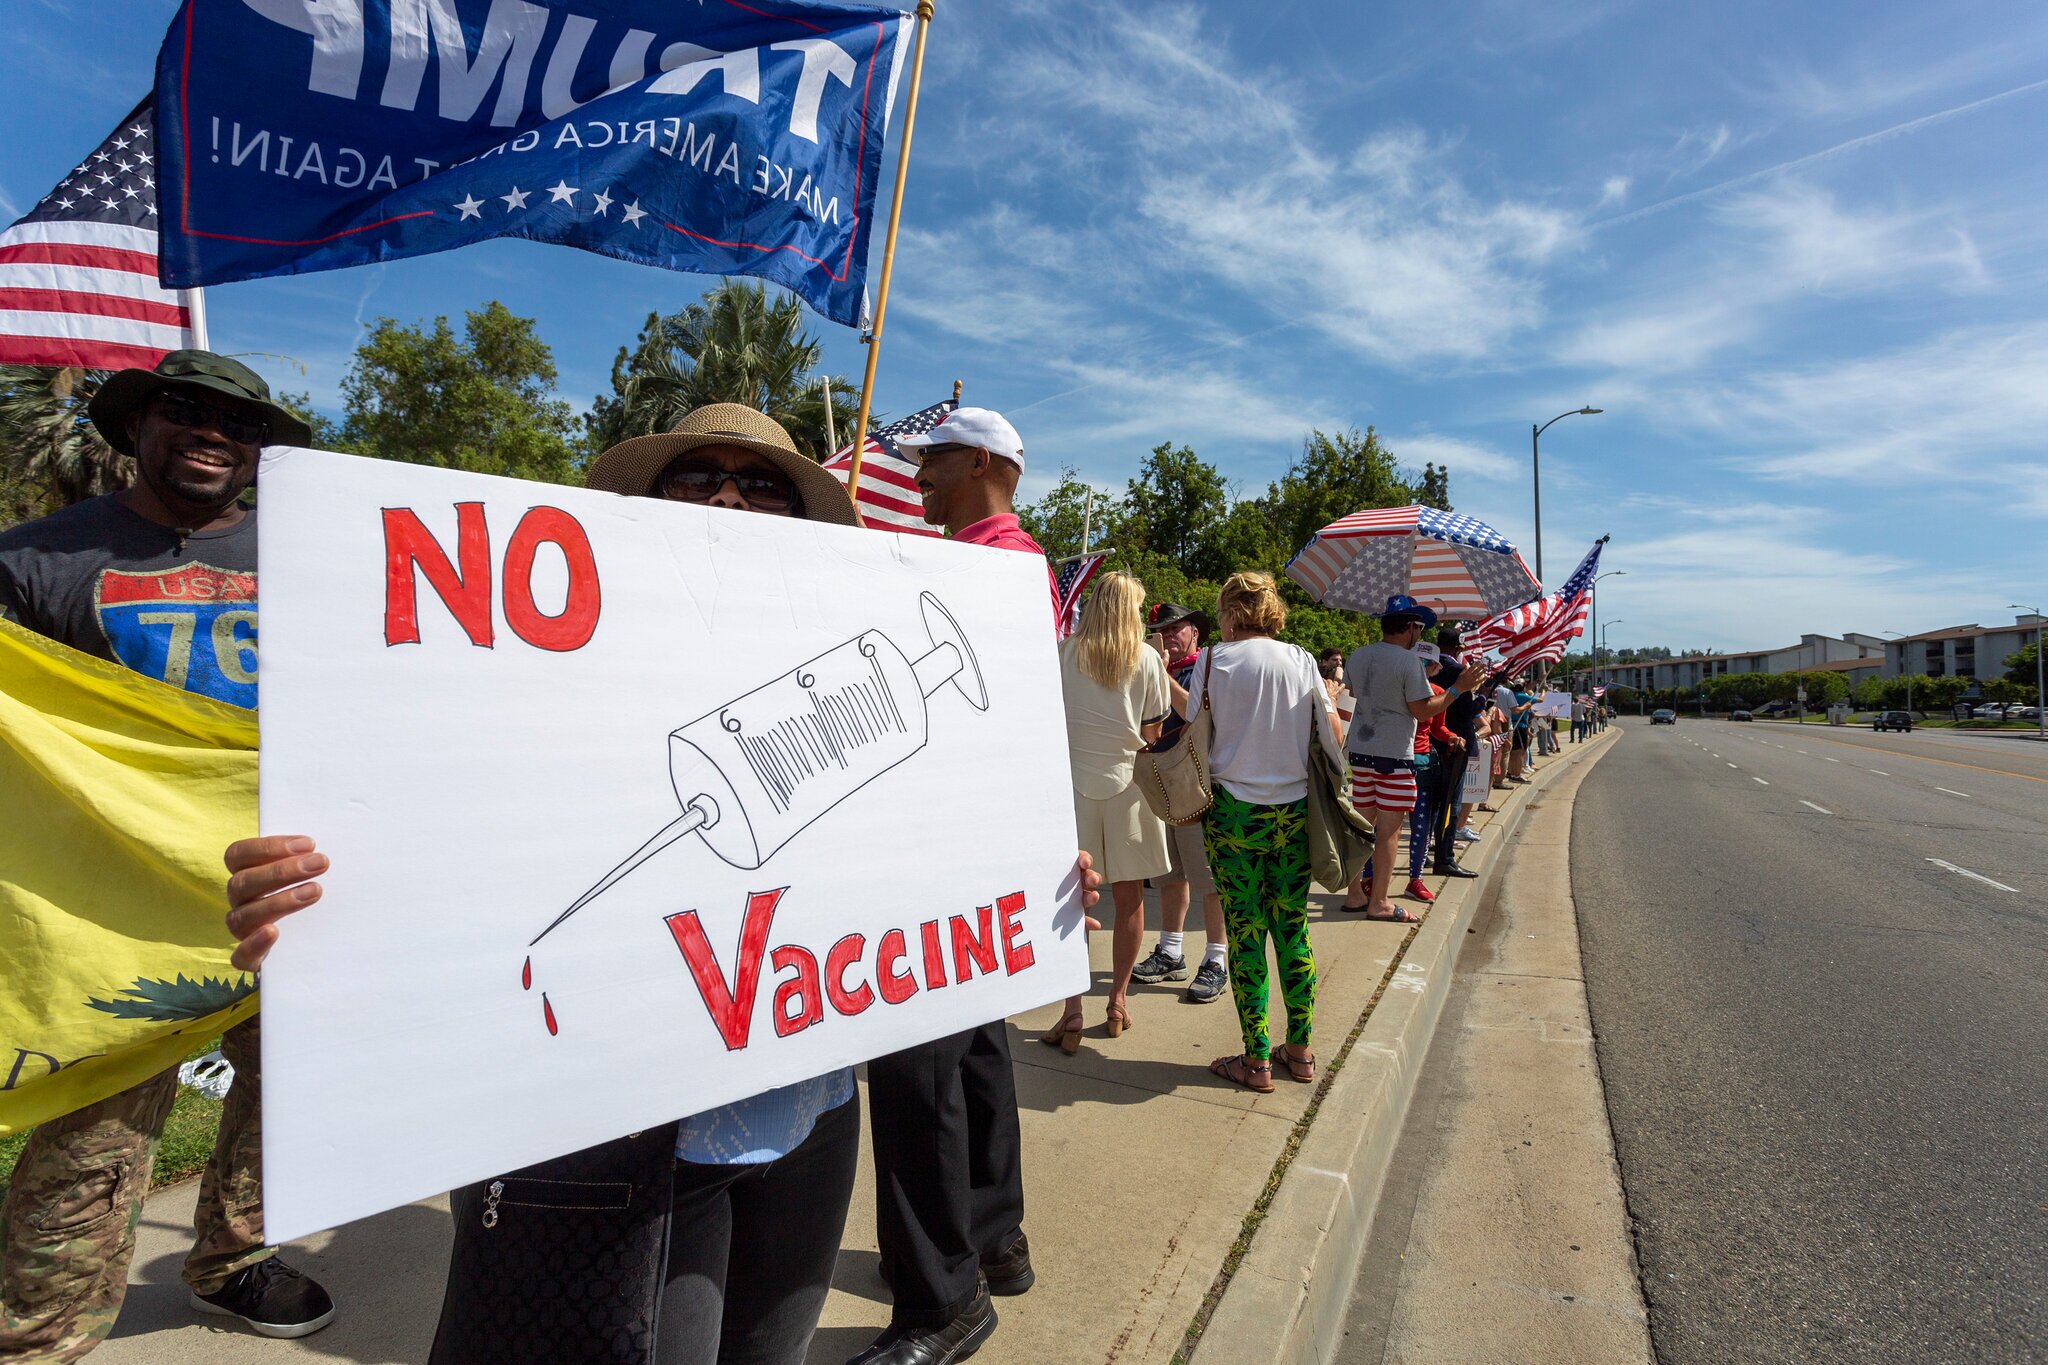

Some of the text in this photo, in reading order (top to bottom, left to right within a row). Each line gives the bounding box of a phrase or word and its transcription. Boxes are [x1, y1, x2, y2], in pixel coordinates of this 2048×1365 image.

[158, 577, 244, 598] USA
[380, 501, 601, 652] NO
[137, 610, 258, 691] 76
